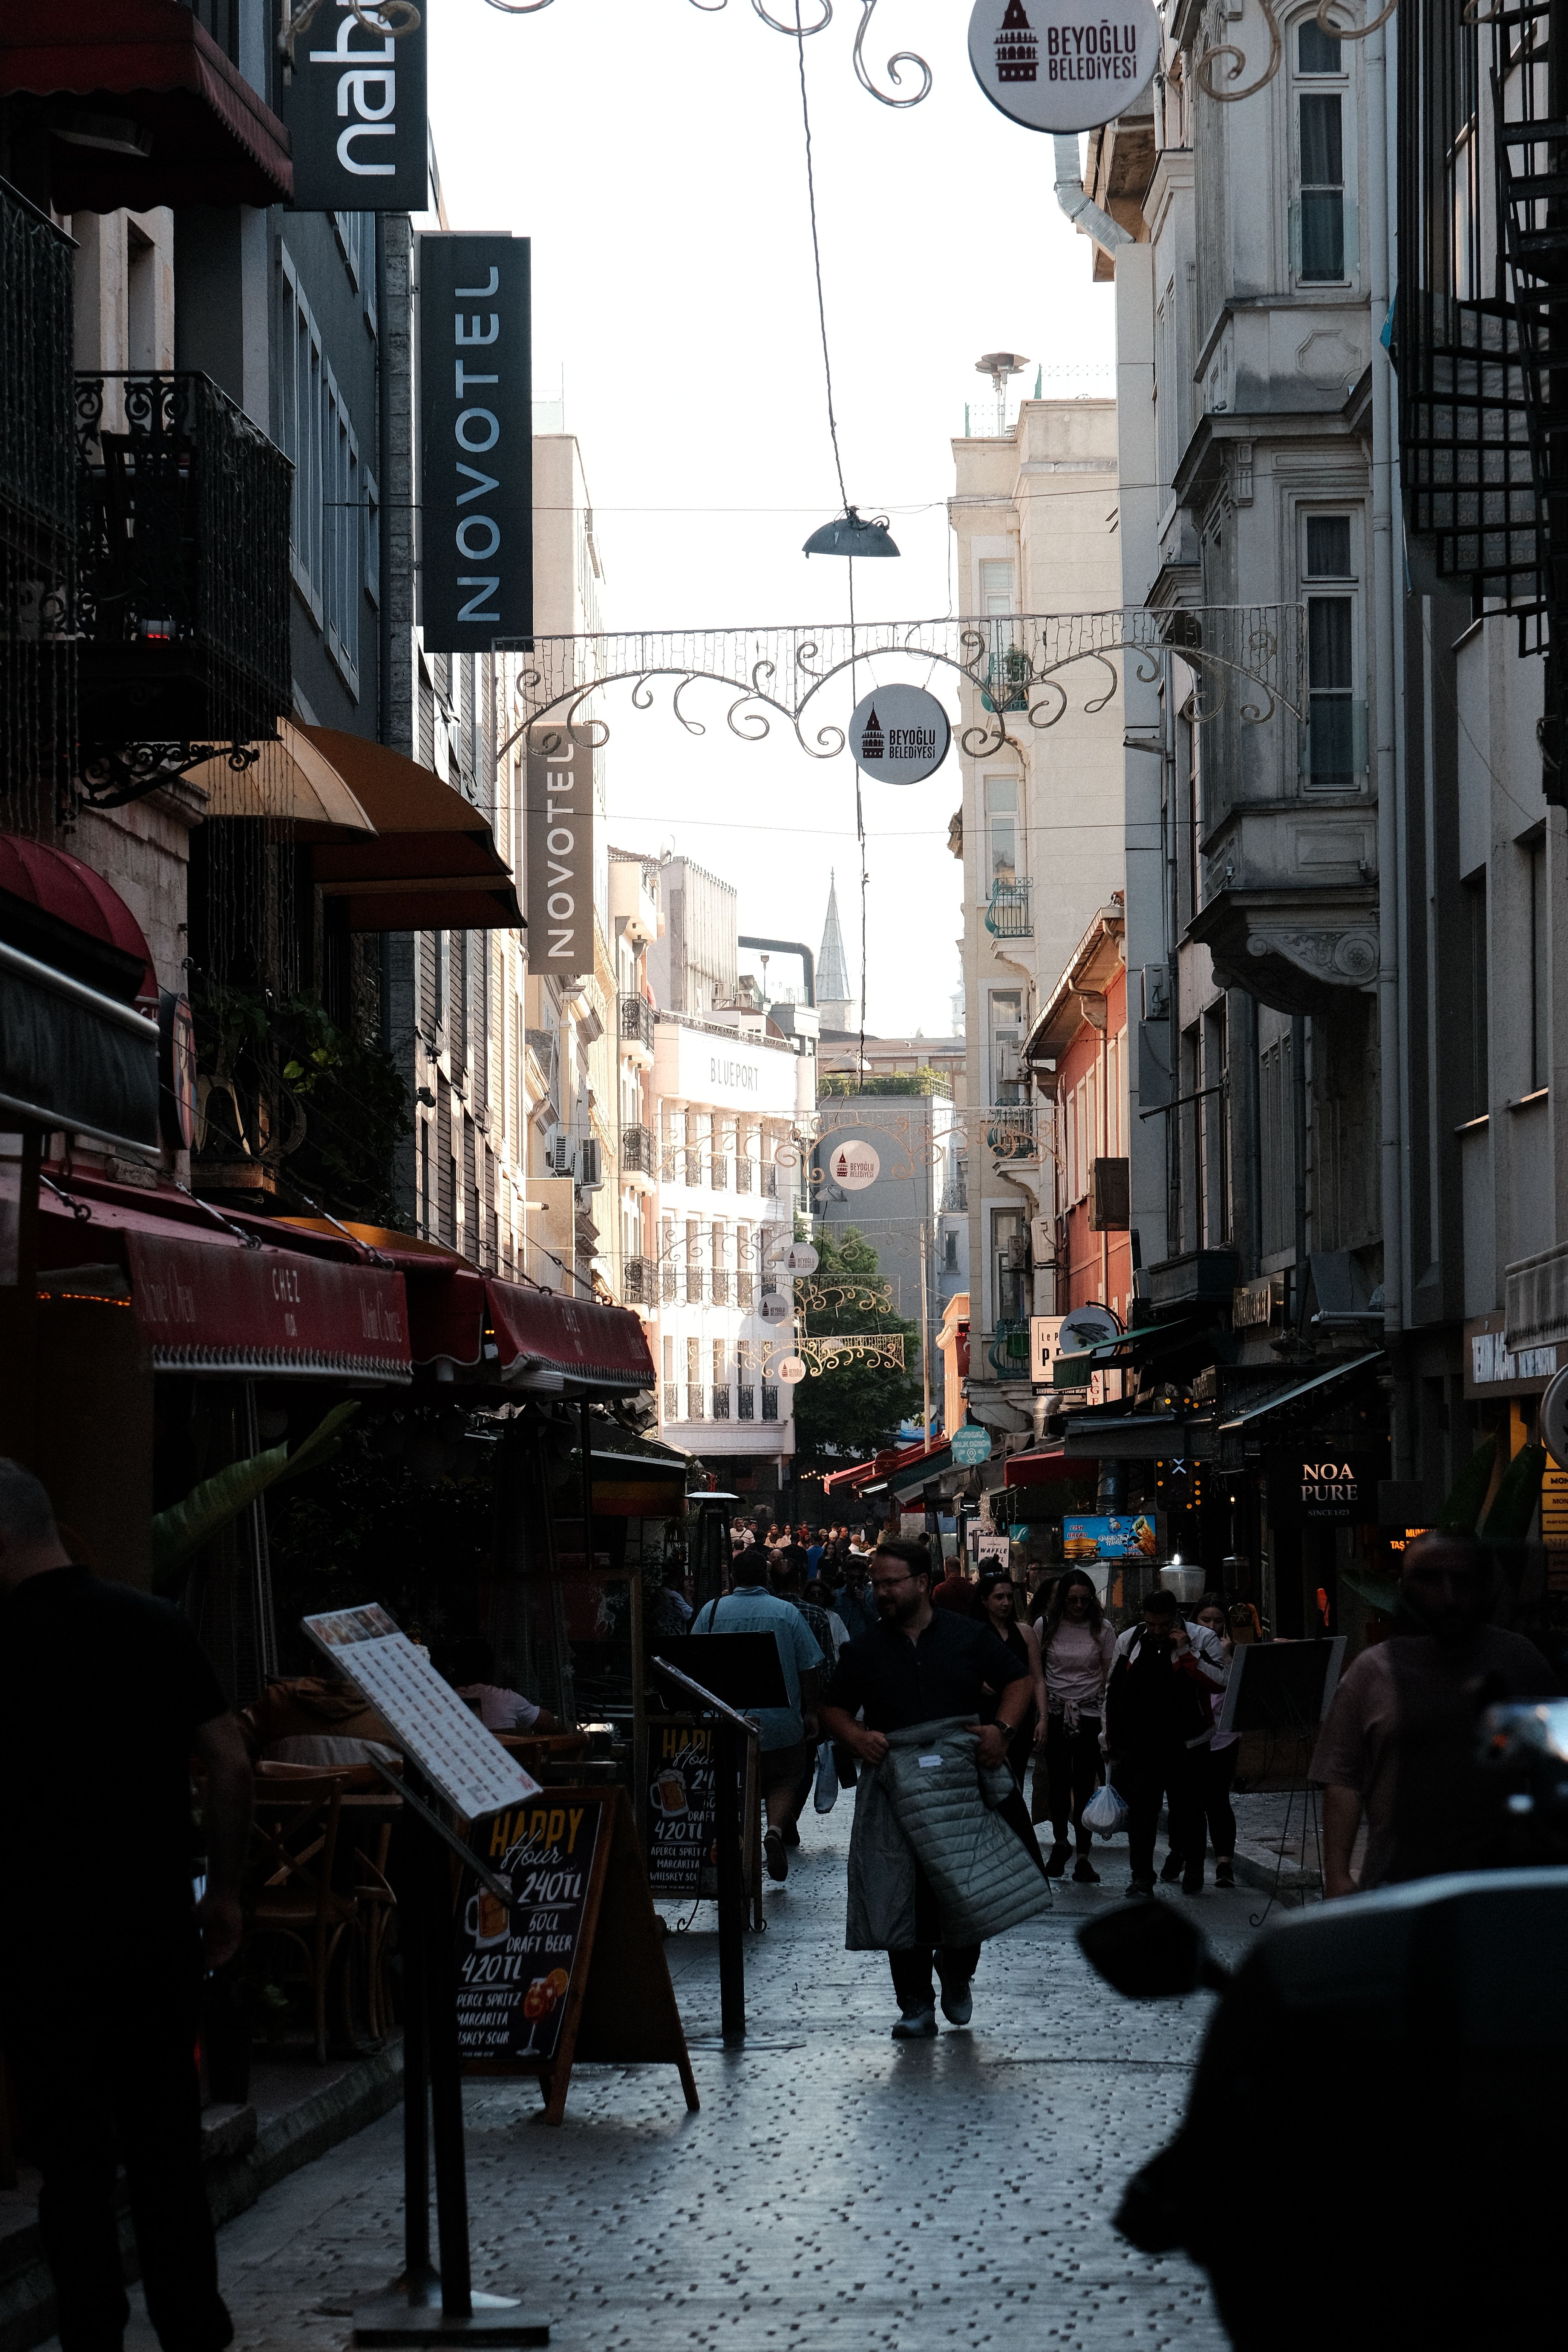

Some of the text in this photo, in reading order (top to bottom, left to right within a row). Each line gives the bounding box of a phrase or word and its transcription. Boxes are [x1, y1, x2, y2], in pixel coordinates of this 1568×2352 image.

[1048, 20, 1136, 55] BEYOĞLU
[1049, 55, 1138, 81] BELEDİYESİ
[310, 0, 396, 175] nab
[455, 266, 501, 622] NOVOTEL
[890, 726, 936, 745] BEYOĞLU
[890, 746, 936, 758] BELEDİYESİ
[547, 743, 574, 957] NOVOTEL
[711, 1057, 759, 1092] BLUEPORT
[850, 1162, 874, 1171] BEYOĞLU
[273, 1268, 300, 1303] CHEZ
[1303, 1463, 1355, 1480] NOA
[1300, 1484, 1358, 1501] PURE
[1390, 1540, 1405, 1551] TAŞ
[489, 1808, 585, 1857] HAPPY
[654, 1820, 703, 1840] 420TL
[500, 1828, 563, 1873] Hour
[651, 1847, 677, 1856] APEROL
[517, 1868, 582, 1903] 240TL
[649, 1872, 683, 1881] WHISKEY
[528, 1912, 559, 1932] 50CL
[506, 1934, 573, 1953] DRAFT BEER
[461, 1951, 522, 1983] 420TL
[456, 1992, 522, 2009] PEROL SPRITZ
[485, 2030, 510, 2045] SOUR
